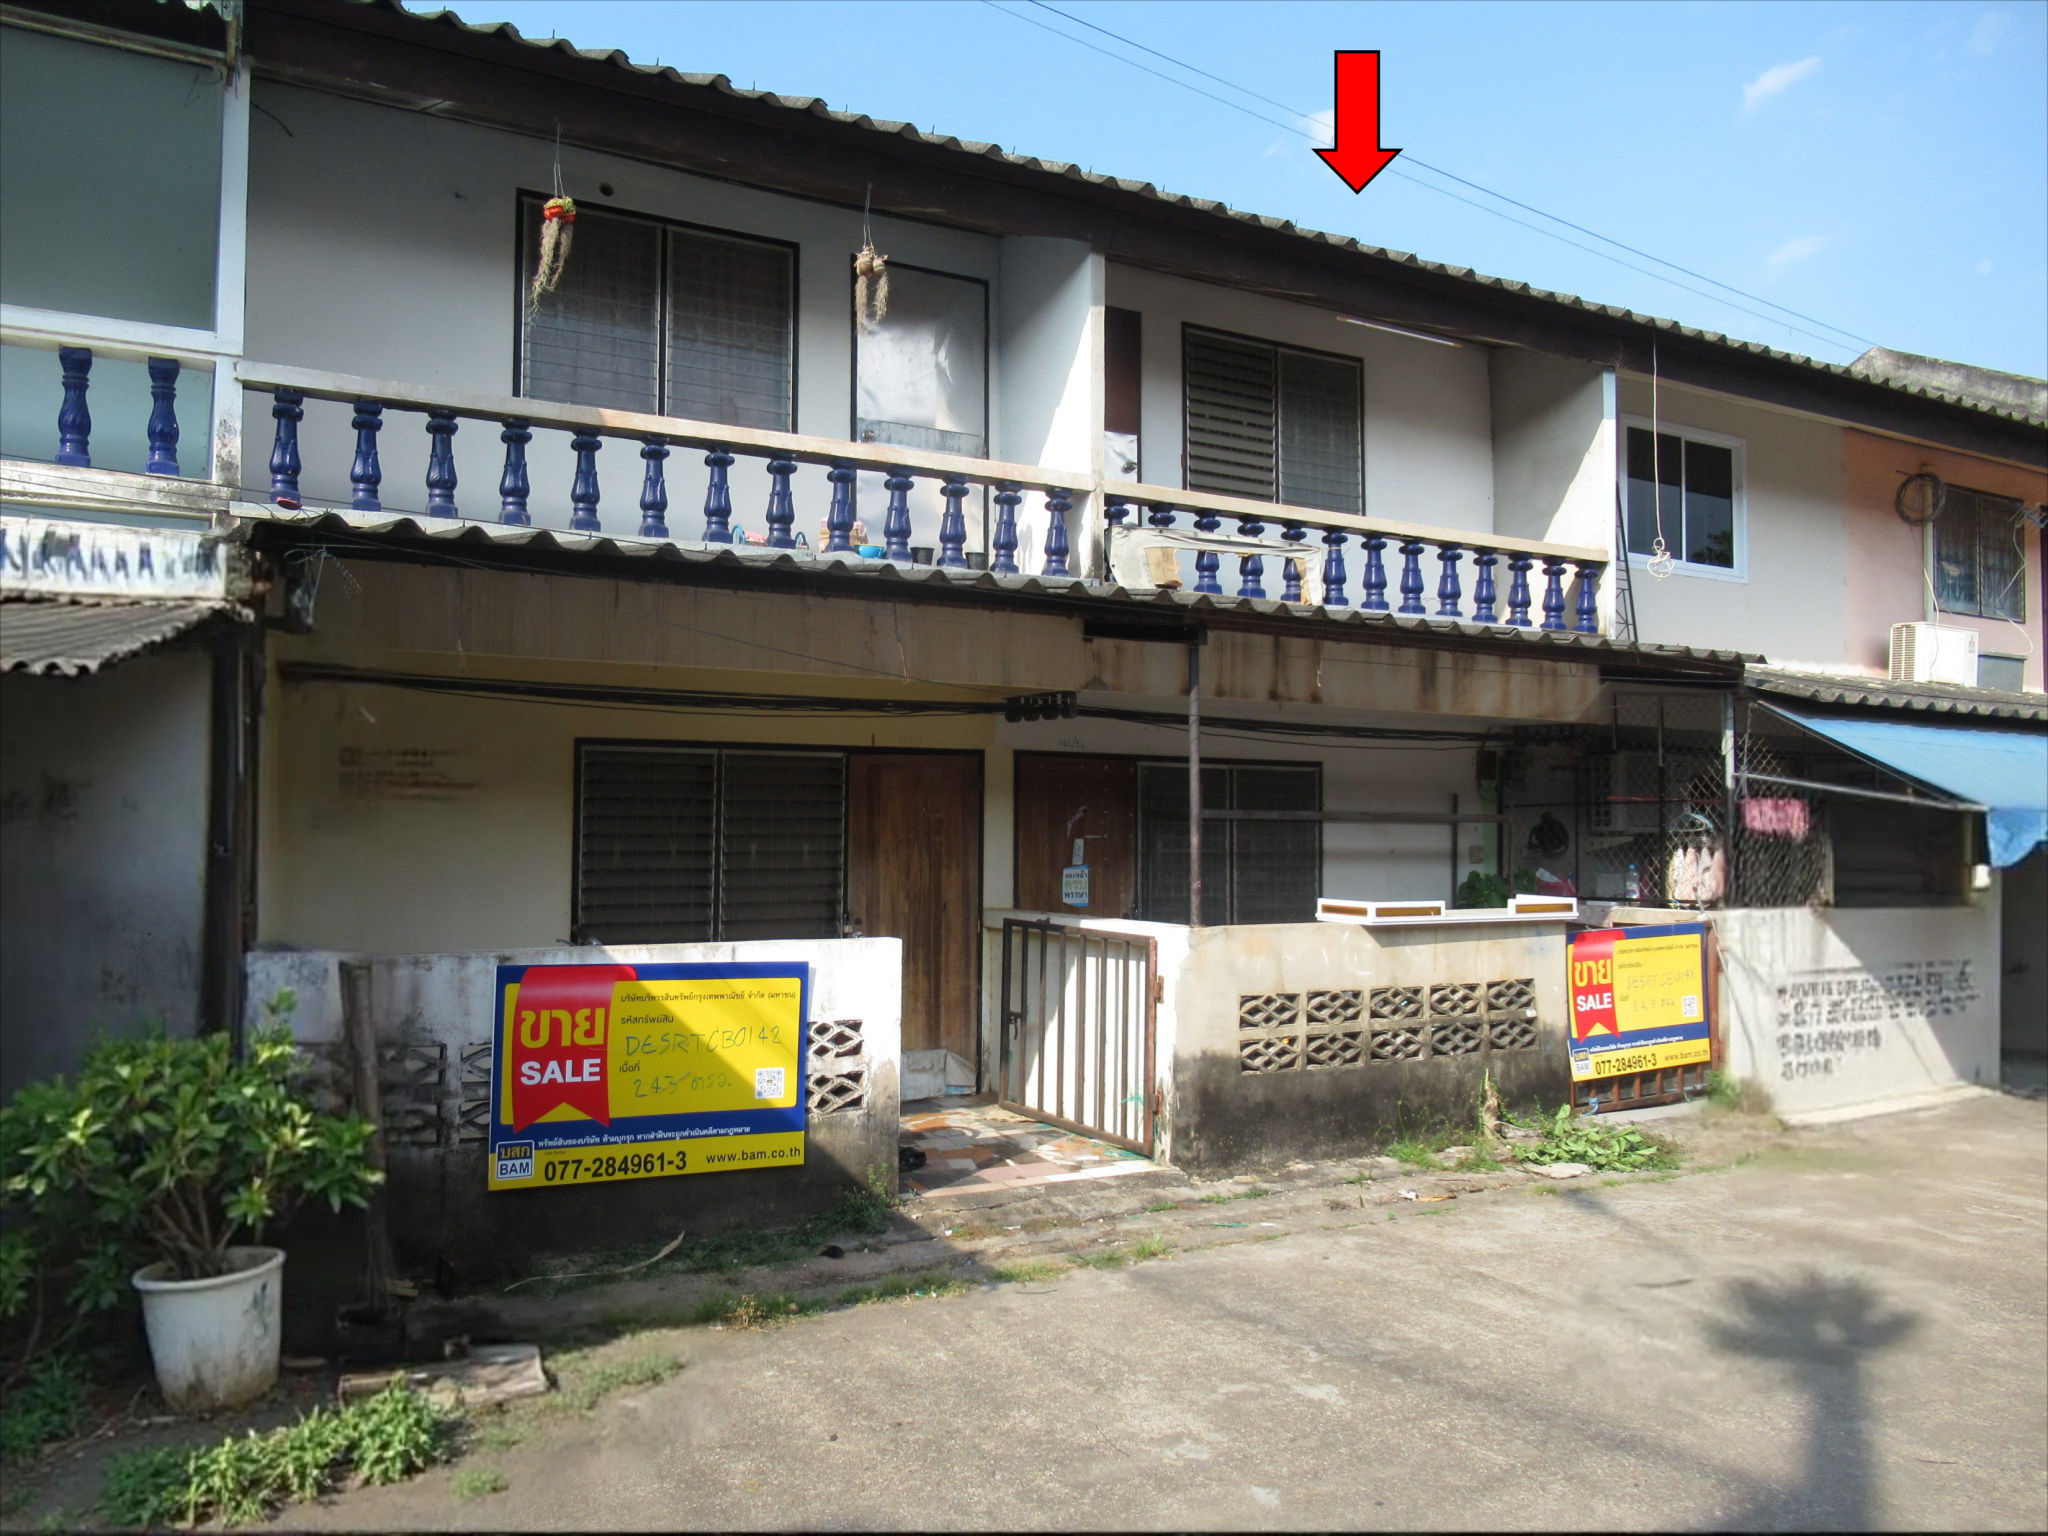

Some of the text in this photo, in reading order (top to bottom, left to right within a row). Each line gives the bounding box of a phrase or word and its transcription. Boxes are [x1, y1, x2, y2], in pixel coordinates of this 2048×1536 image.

[1573, 959, 1612, 987] ขาย
[748, 989, 765, 999] จำกัด
[767, 990, 796, 1000] (มหาชน)
[1576, 992, 1613, 1011] SALE
[620, 1013, 674, 1025] รหัสทรัพย์สิน
[520, 1007, 606, 1048] ขาย
[520, 1058, 601, 1085] SALE
[619, 1061, 641, 1073] เนื้อที่
[1576, 1061, 1590, 1072] BAM
[1595, 1053, 1657, 1075] 077-284961-3
[538, 1135, 600, 1148] ทรัพย์สินของบริษัท
[602, 1133, 635, 1145] ห้ามบุกรุก
[500, 1145, 530, 1159] บสก
[706, 1147, 801, 1164] www.bam.co.th
[499, 1162, 530, 1176] BAM
[544, 1151, 687, 1181] 077-284961-3
